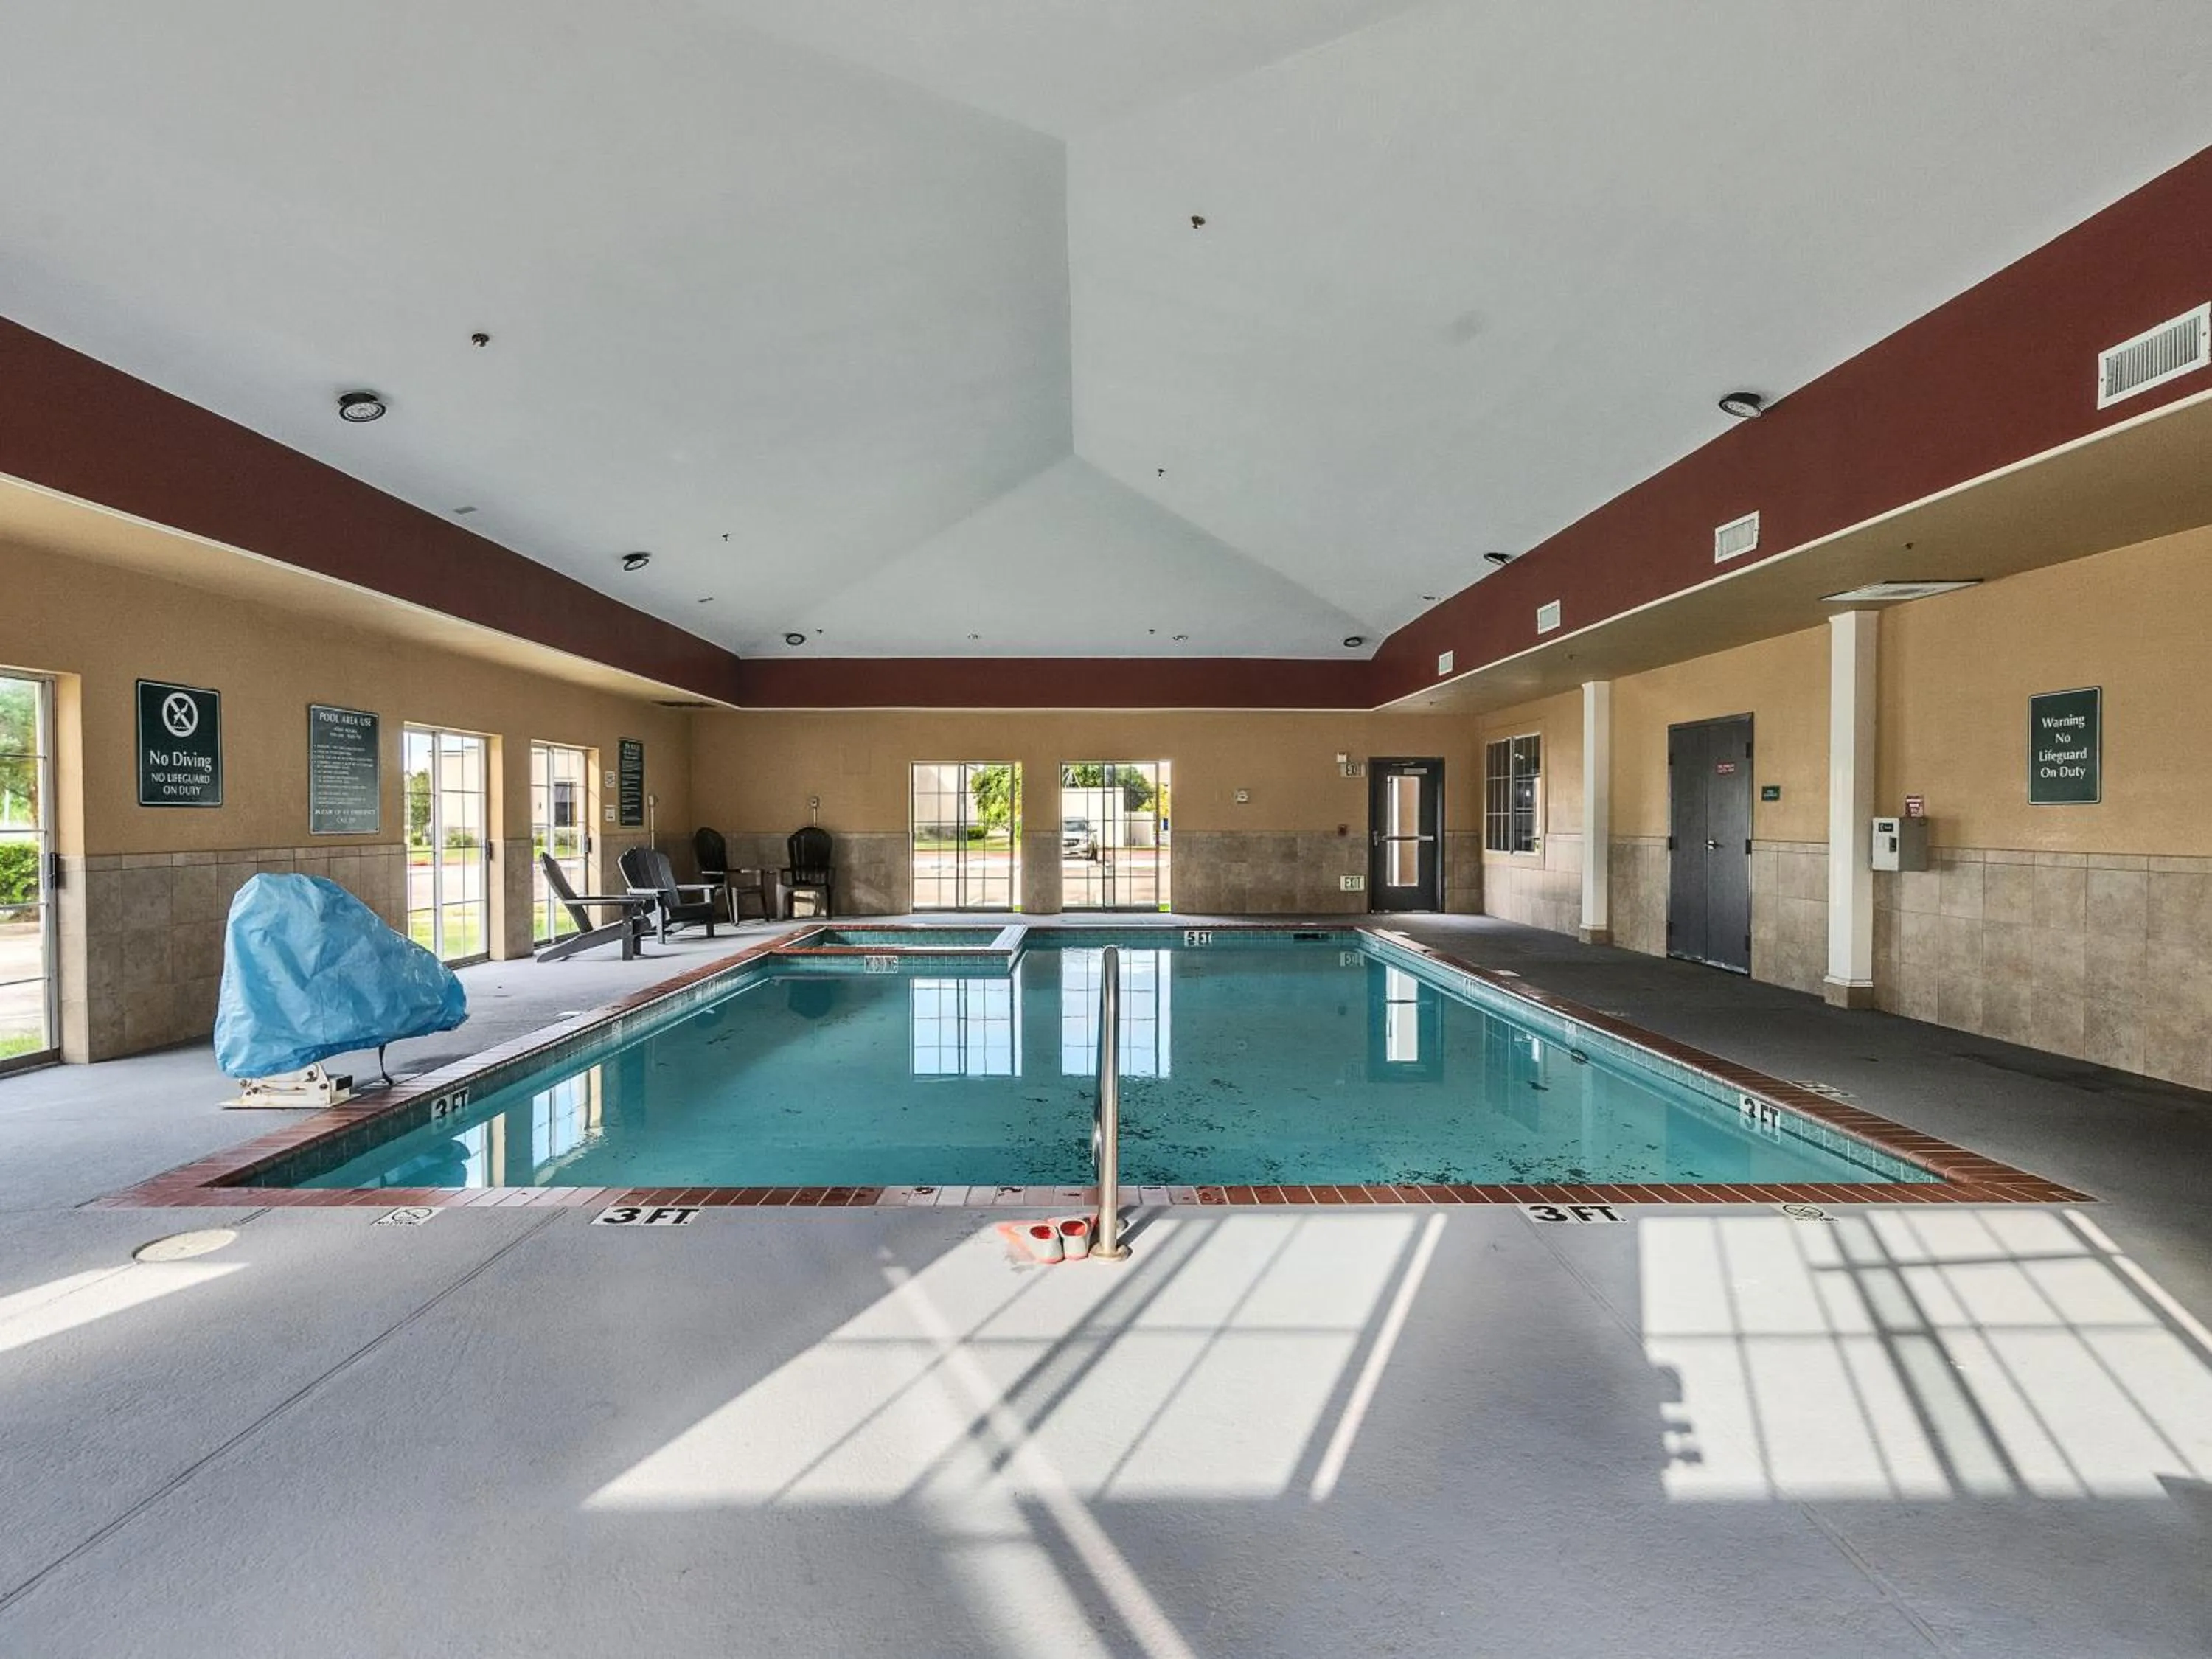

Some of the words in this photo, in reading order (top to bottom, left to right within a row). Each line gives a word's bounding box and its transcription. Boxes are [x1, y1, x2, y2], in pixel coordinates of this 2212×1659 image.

[2042, 713, 2085, 728] Warning
[2055, 732, 2071, 743] No
[150, 749, 169, 765] No
[173, 751, 212, 773] Diving
[2039, 747, 2087, 764] Lifeguard
[151, 772, 166, 782] NO
[167, 773, 210, 784] LIFEGUARD
[2040, 767, 2056, 778] On
[2059, 766, 2086, 779] Duty
[163, 785, 177, 795] ON
[179, 785, 201, 796] DUTY
[452, 1088, 468, 1112] FT
[602, 1208, 642, 1224] 3
[1528, 1206, 1568, 1222] 3
